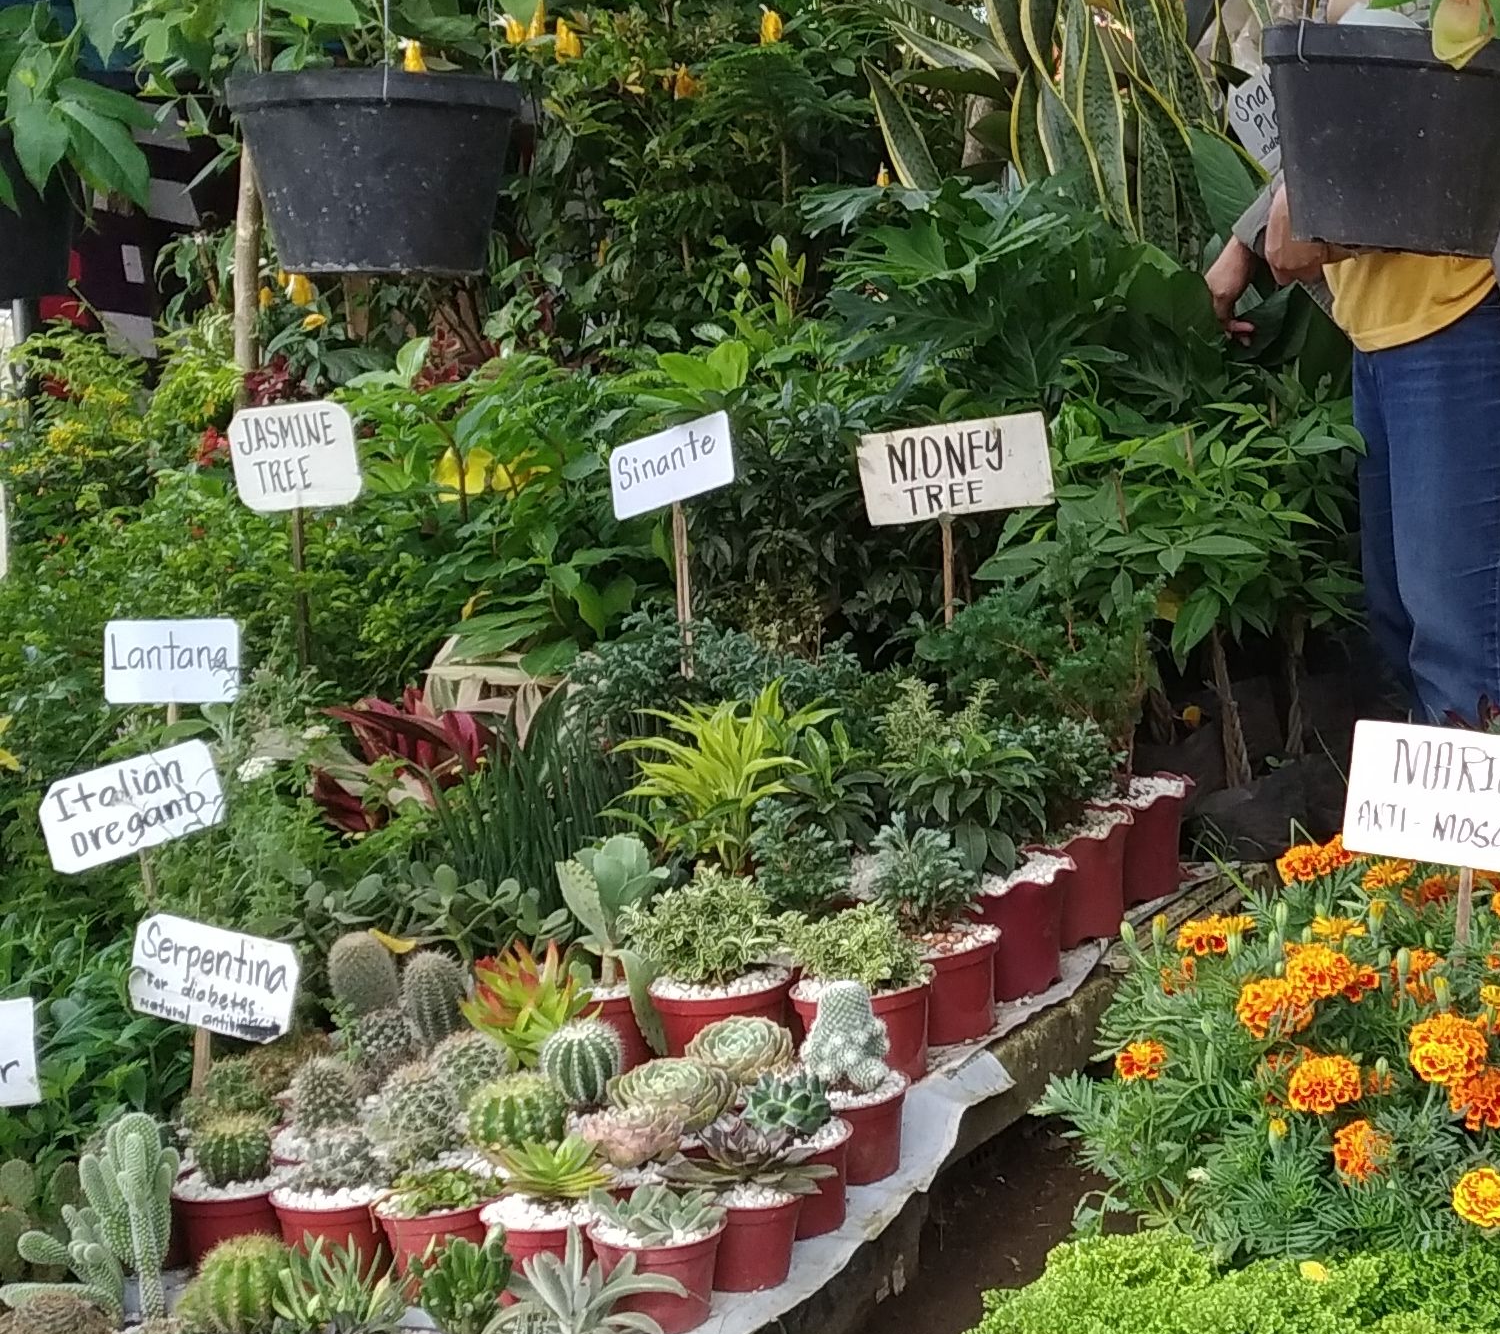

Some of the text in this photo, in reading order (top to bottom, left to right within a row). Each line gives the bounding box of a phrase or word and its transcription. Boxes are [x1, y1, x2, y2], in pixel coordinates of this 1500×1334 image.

[237, 411, 336, 455] JASMINE
[885, 428, 1003, 484] MONEY
[253, 454, 312, 494] TREE
[617, 430, 716, 491] Sinante
[903, 479, 983, 516] TREE
[111, 631, 228, 671] Lantana
[49, 759, 184, 823] Italian
[142, 921, 288, 994] Serpentina
